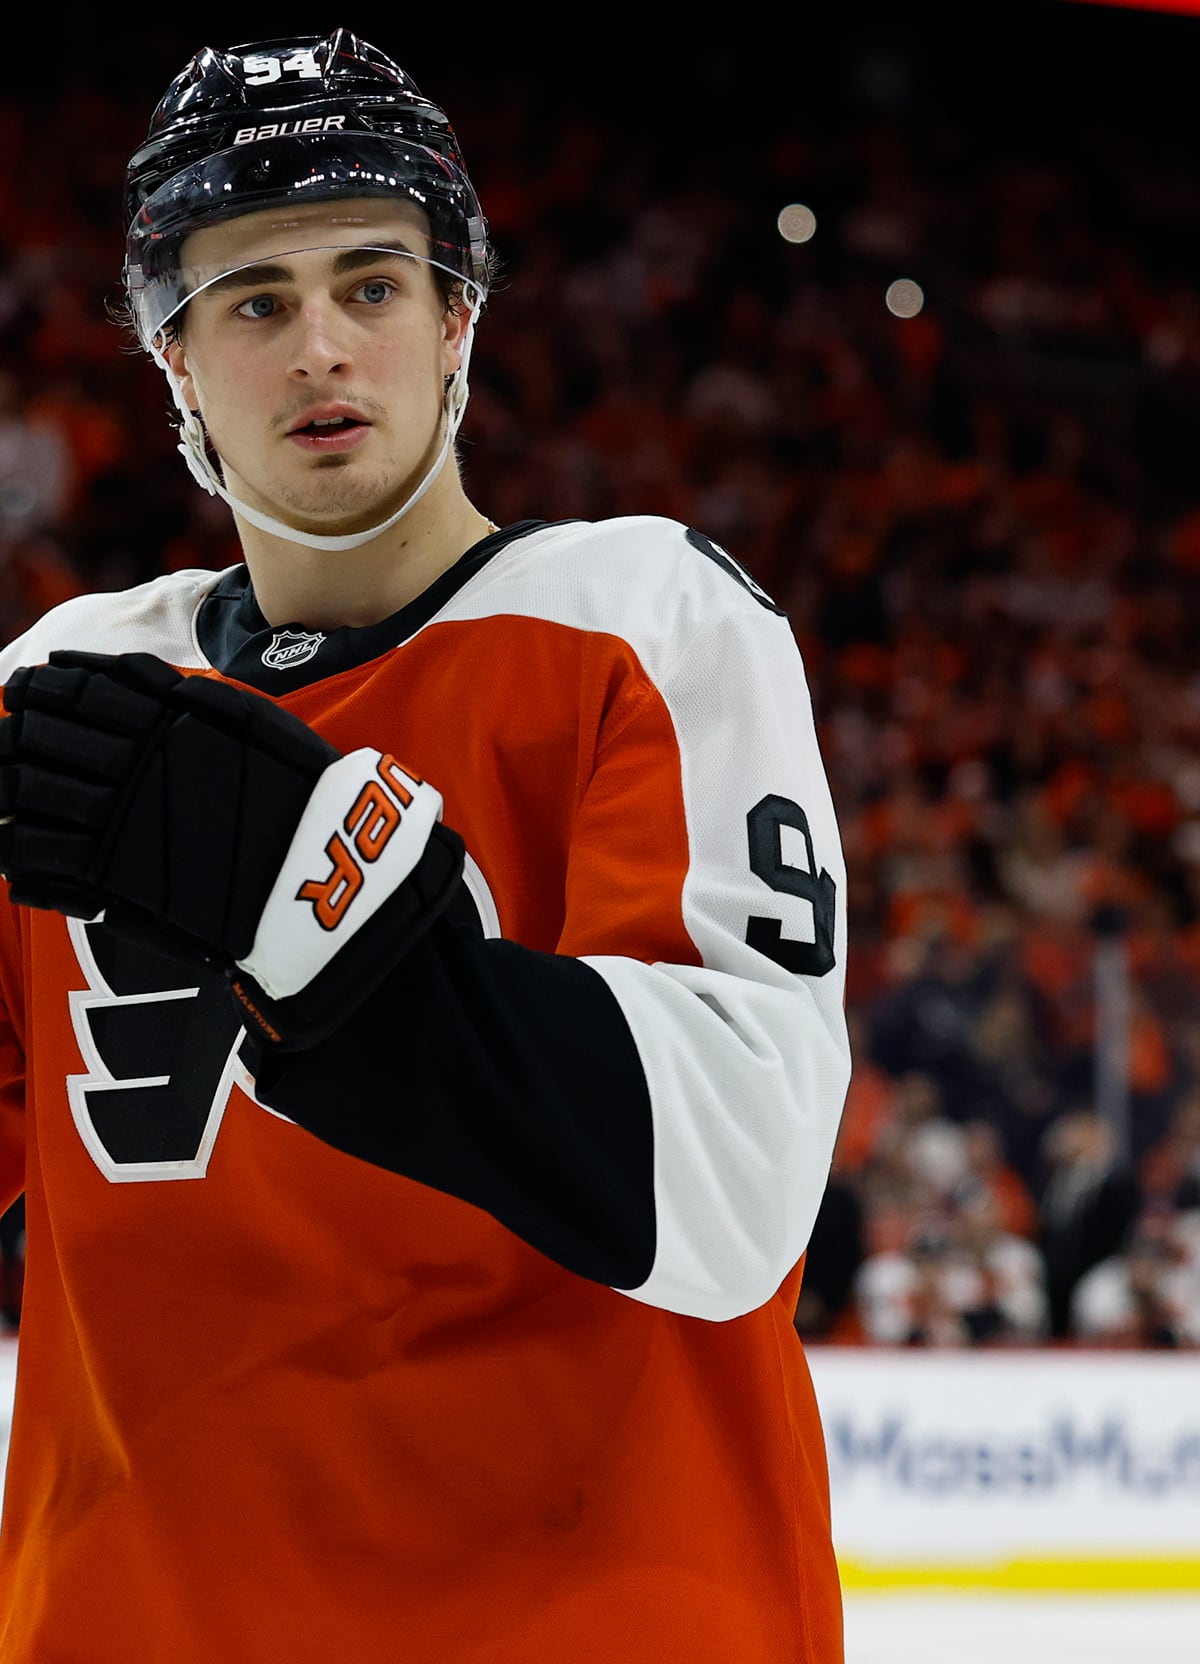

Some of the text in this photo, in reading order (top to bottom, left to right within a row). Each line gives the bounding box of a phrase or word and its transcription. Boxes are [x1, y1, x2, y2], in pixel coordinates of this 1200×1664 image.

[242, 52, 322, 86] 94
[274, 642, 313, 662] NHL
[295, 753, 424, 932] UER
